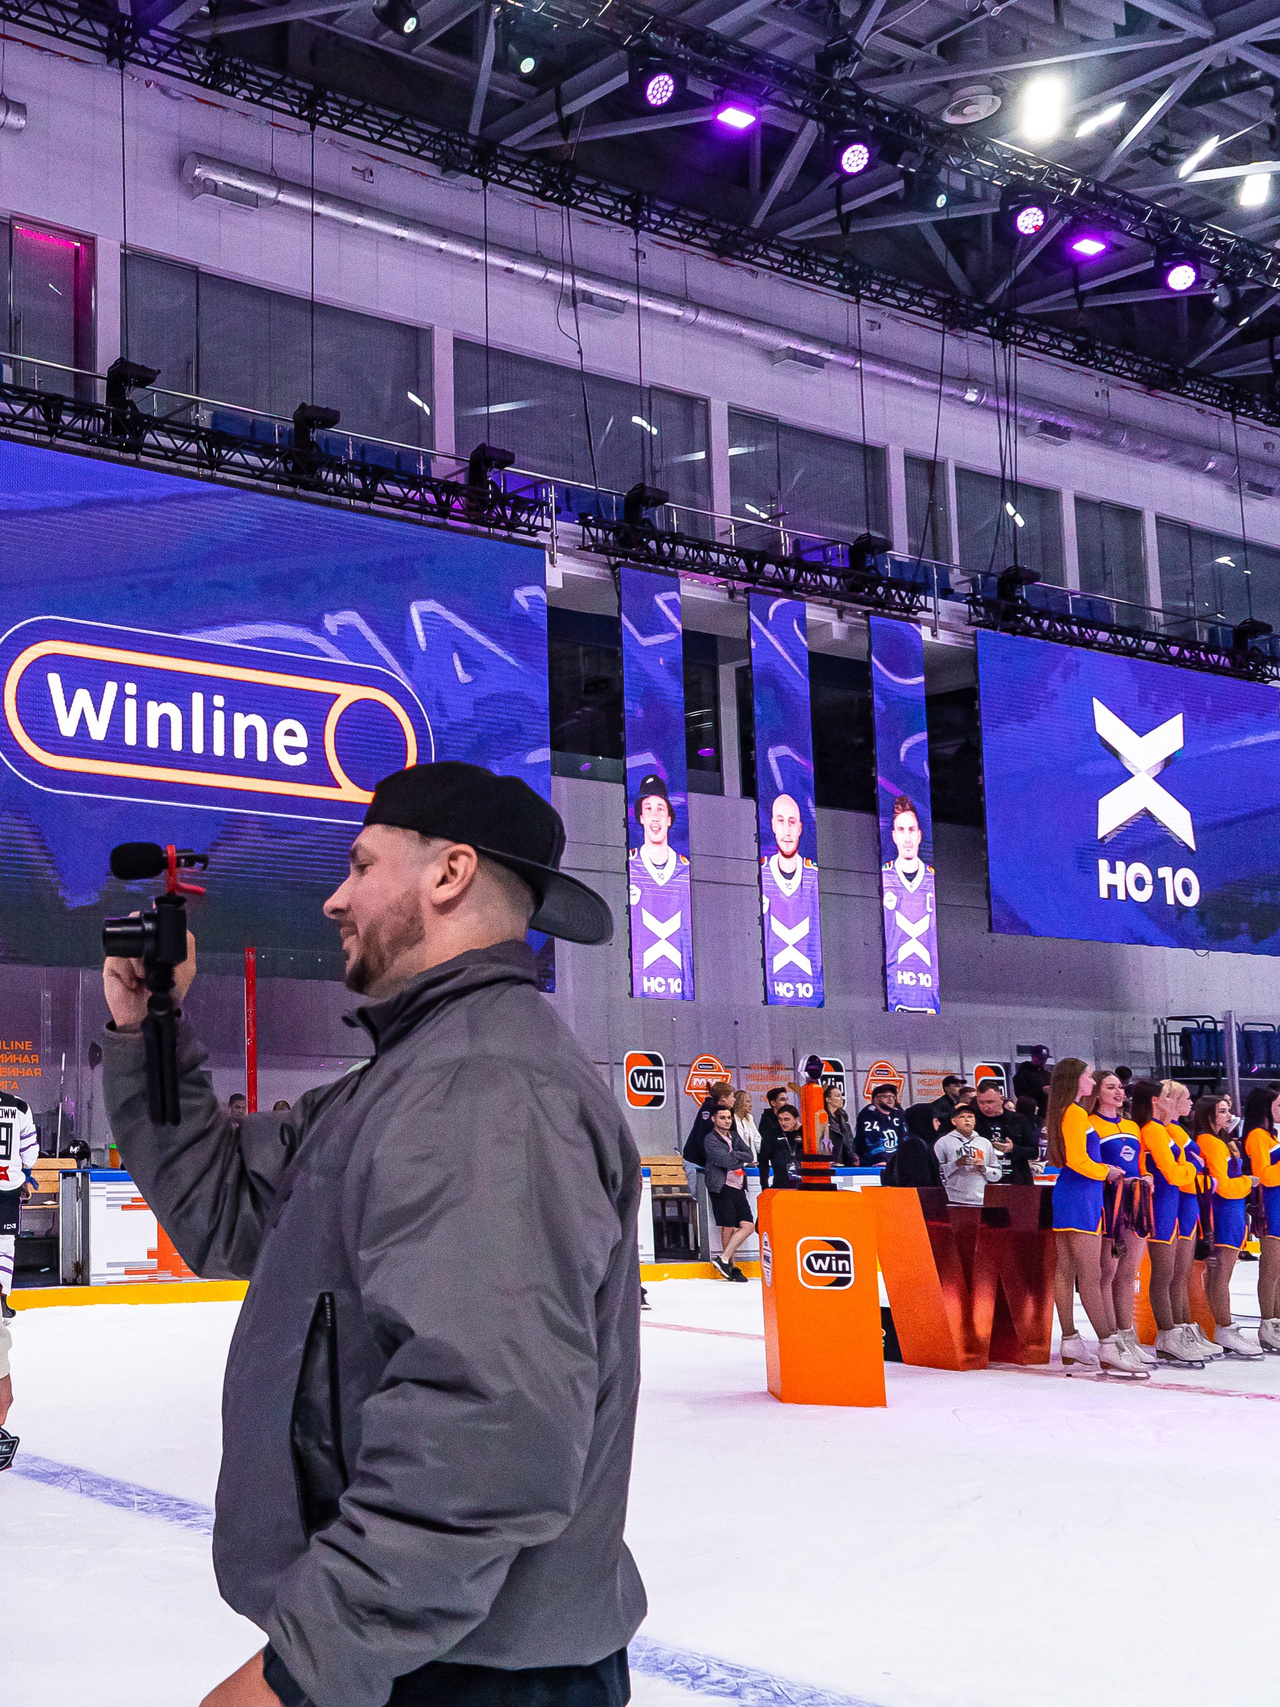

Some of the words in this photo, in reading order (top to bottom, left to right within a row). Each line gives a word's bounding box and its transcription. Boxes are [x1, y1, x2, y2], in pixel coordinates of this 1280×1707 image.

[47, 673, 308, 766] Winline
[1098, 859, 1153, 903] HC
[1157, 866, 1200, 908] 10
[643, 976, 666, 993] HC
[667, 977, 682, 993] 10
[897, 970, 917, 986] HC
[917, 972, 932, 988] 10
[774, 981, 795, 998] HC
[795, 982, 814, 998] 10
[634, 1071, 663, 1090] Win
[864, 1121, 880, 1132] 24
[893, 1117, 900, 1127] C
[810, 1255, 850, 1271] Win
